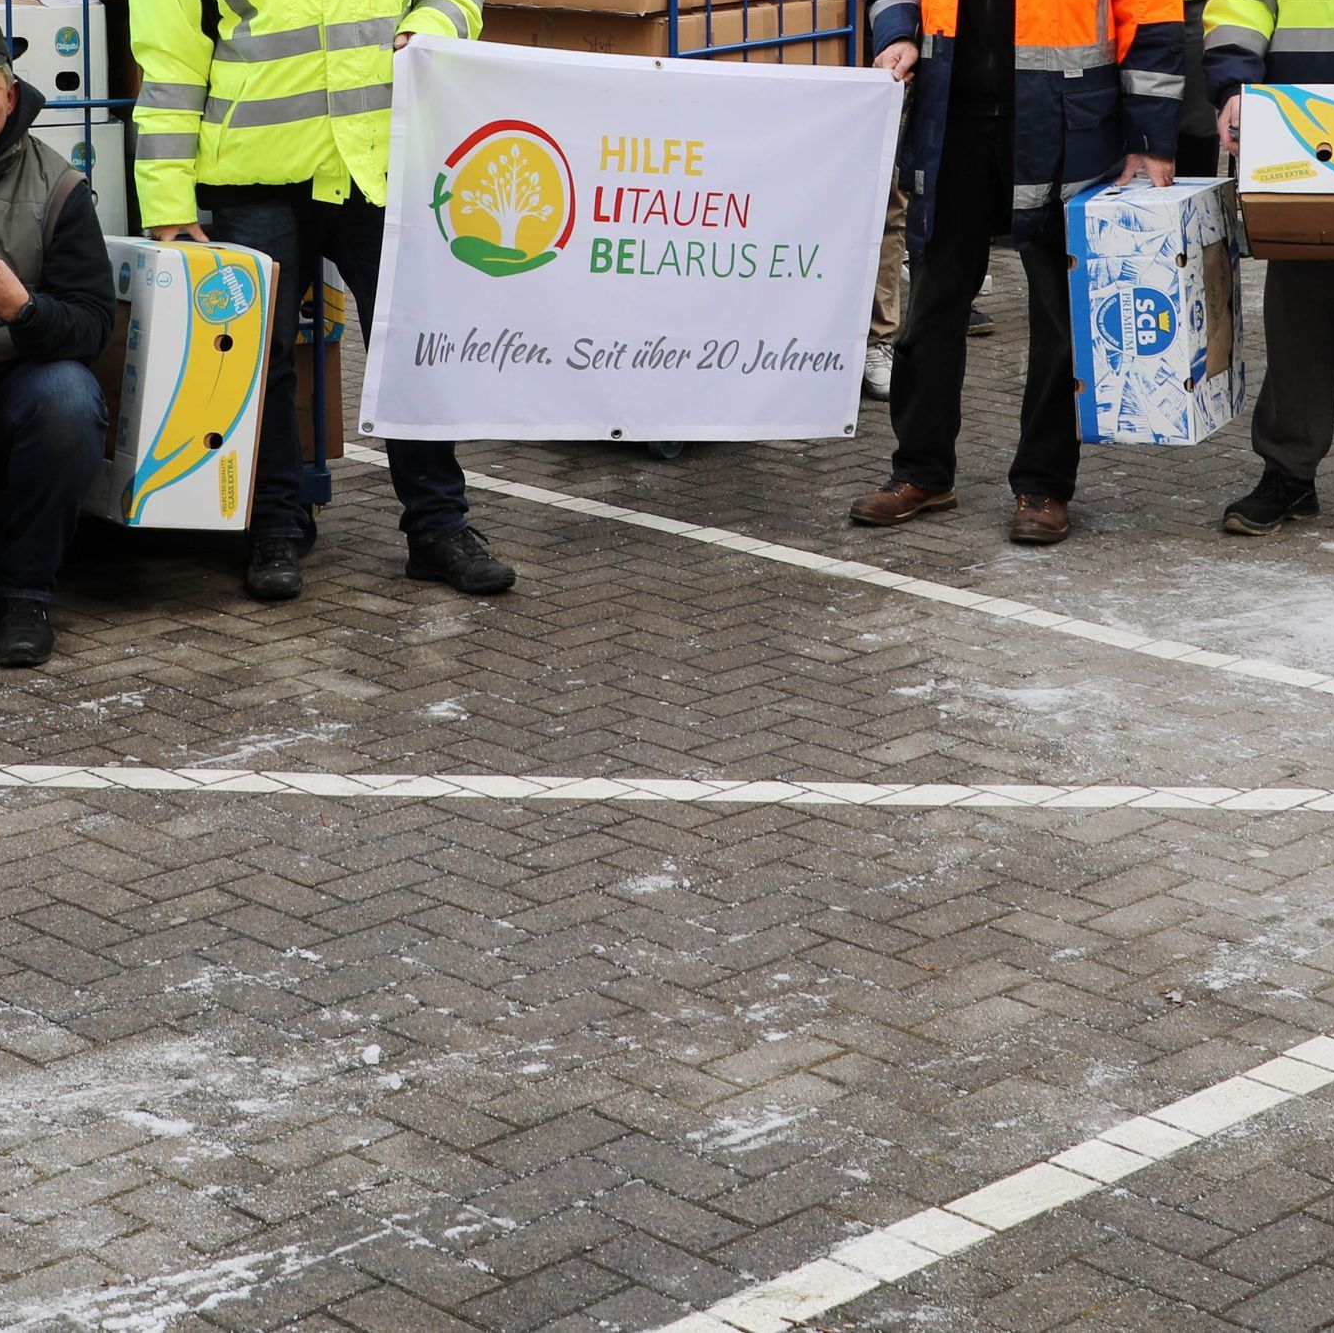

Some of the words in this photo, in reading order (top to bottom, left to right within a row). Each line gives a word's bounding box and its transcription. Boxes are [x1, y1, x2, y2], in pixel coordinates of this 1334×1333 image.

[599, 134, 705, 177] HILFE
[1257, 165, 1284, 174] SELECTED
[1285, 162, 1310, 171] QUALITY
[1260, 172, 1284, 181] CLASS
[1284, 169, 1310, 179] EXTRA
[593, 185, 751, 228] LITAUEN
[590, 237, 758, 279] BELARUS
[768, 243, 823, 279] E.V.
[218, 265, 250, 315] Chiquita
[1121, 292, 1135, 352] PREMIUM
[1135, 298, 1157, 346] SCB
[414, 332, 455, 367] Wir
[460, 326, 553, 373] helfen.
[566, 337, 628, 371] Seit
[631, 335, 691, 371] über
[696, 339, 740, 371] 20
[741, 337, 845, 375] Jahren.
